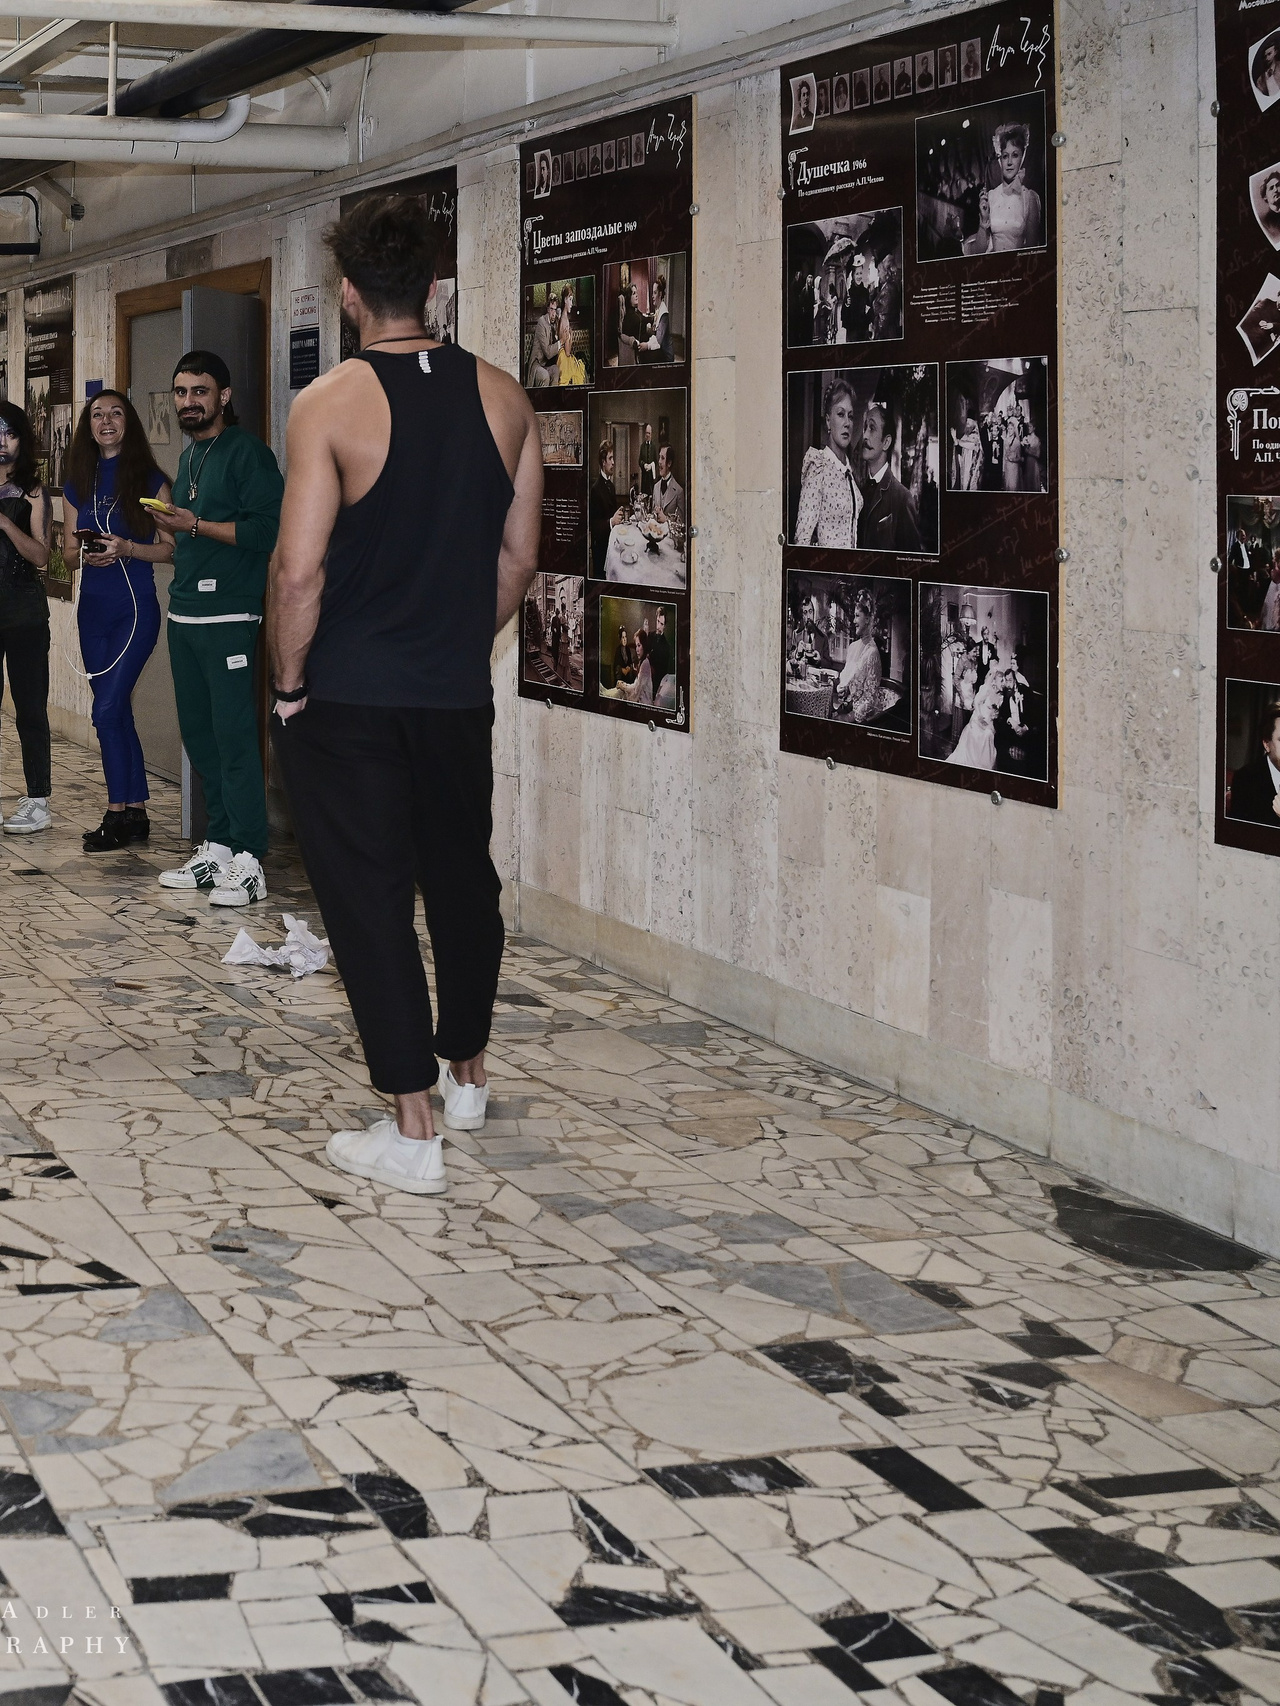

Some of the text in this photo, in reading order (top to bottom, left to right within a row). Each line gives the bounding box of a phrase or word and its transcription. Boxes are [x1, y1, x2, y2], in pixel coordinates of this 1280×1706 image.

[797, 158, 867, 186] Душечка 1966
[533, 220, 638, 255] Цветы запоздалые 1969
[299, 306, 317, 315] SMOKING
[1252, 408, 1280, 429] По
[1252, 439, 1264, 449] По
[1254, 452, 1274, 463] А.П.
